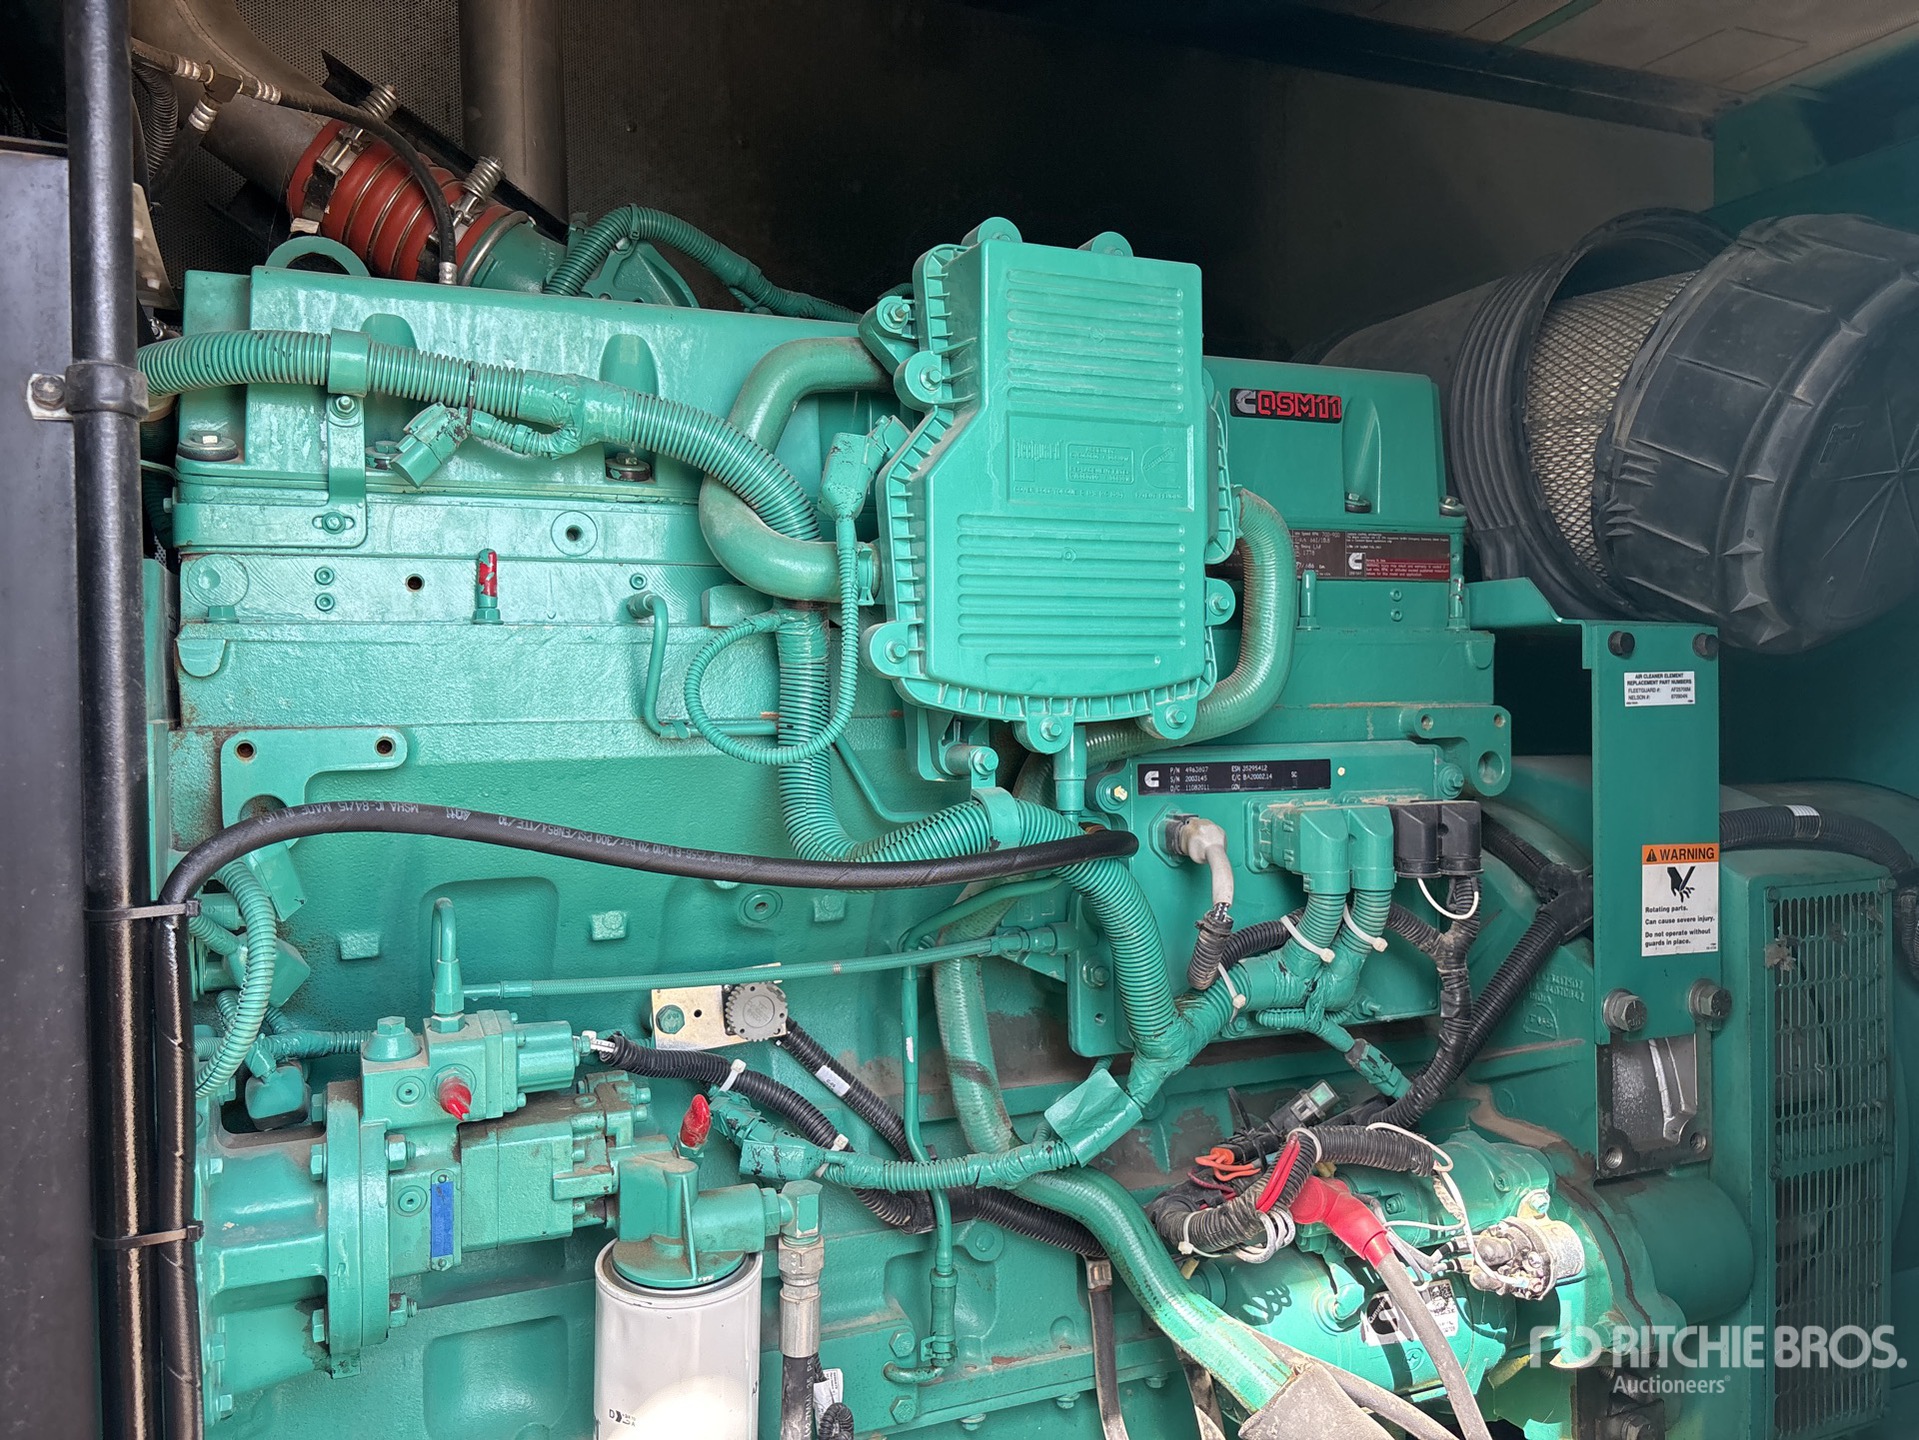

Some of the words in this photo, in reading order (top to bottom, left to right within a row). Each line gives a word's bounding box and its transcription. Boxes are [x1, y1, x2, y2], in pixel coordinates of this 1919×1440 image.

[1257, 390, 1342, 419] QSM11
[1659, 847, 1715, 861] WARNING
[1671, 905, 1688, 913] parts.
[1697, 915, 1715, 923] injury.
[1665, 930, 1688, 938] operate
[1645, 940, 1665, 948] guards
[1673, 938, 1691, 946] place.
